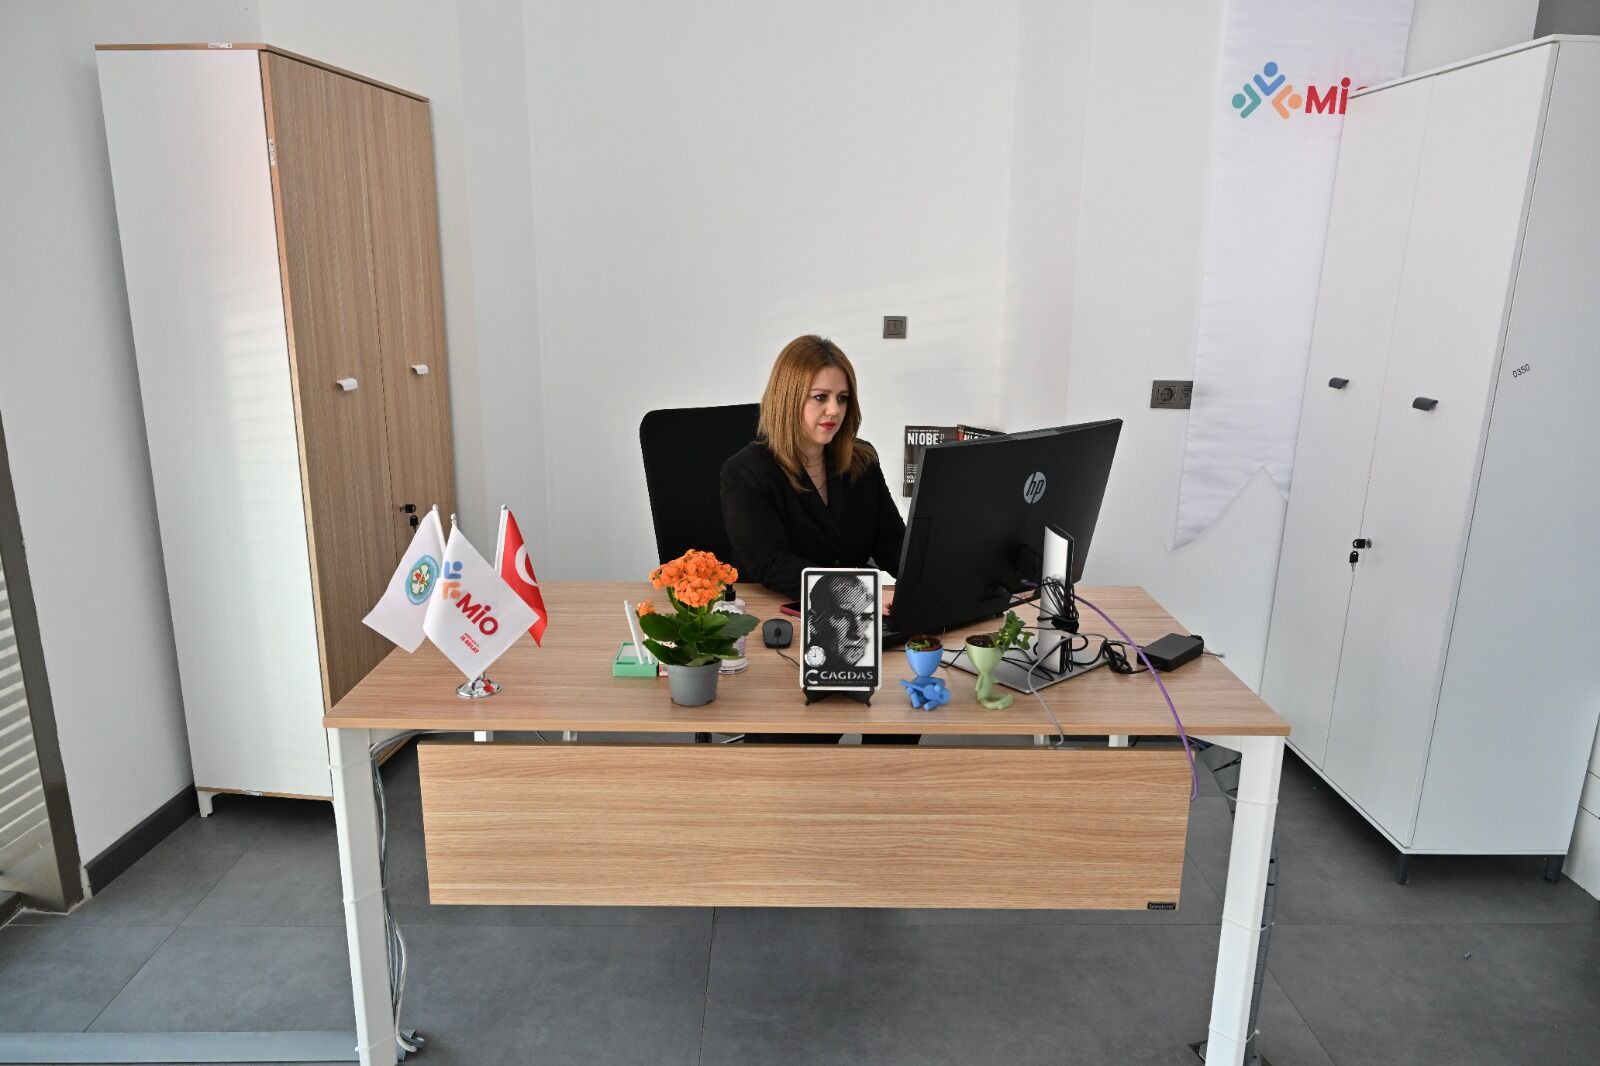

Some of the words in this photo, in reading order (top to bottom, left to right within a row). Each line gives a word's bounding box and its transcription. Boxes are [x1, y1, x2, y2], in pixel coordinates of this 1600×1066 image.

[1305, 77, 1368, 114] Mi
[1513, 364, 1530, 378] 0350
[907, 432, 939, 446] NIOBE
[1024, 472, 1046, 504] hp
[820, 671, 874, 680] CAGDAS
